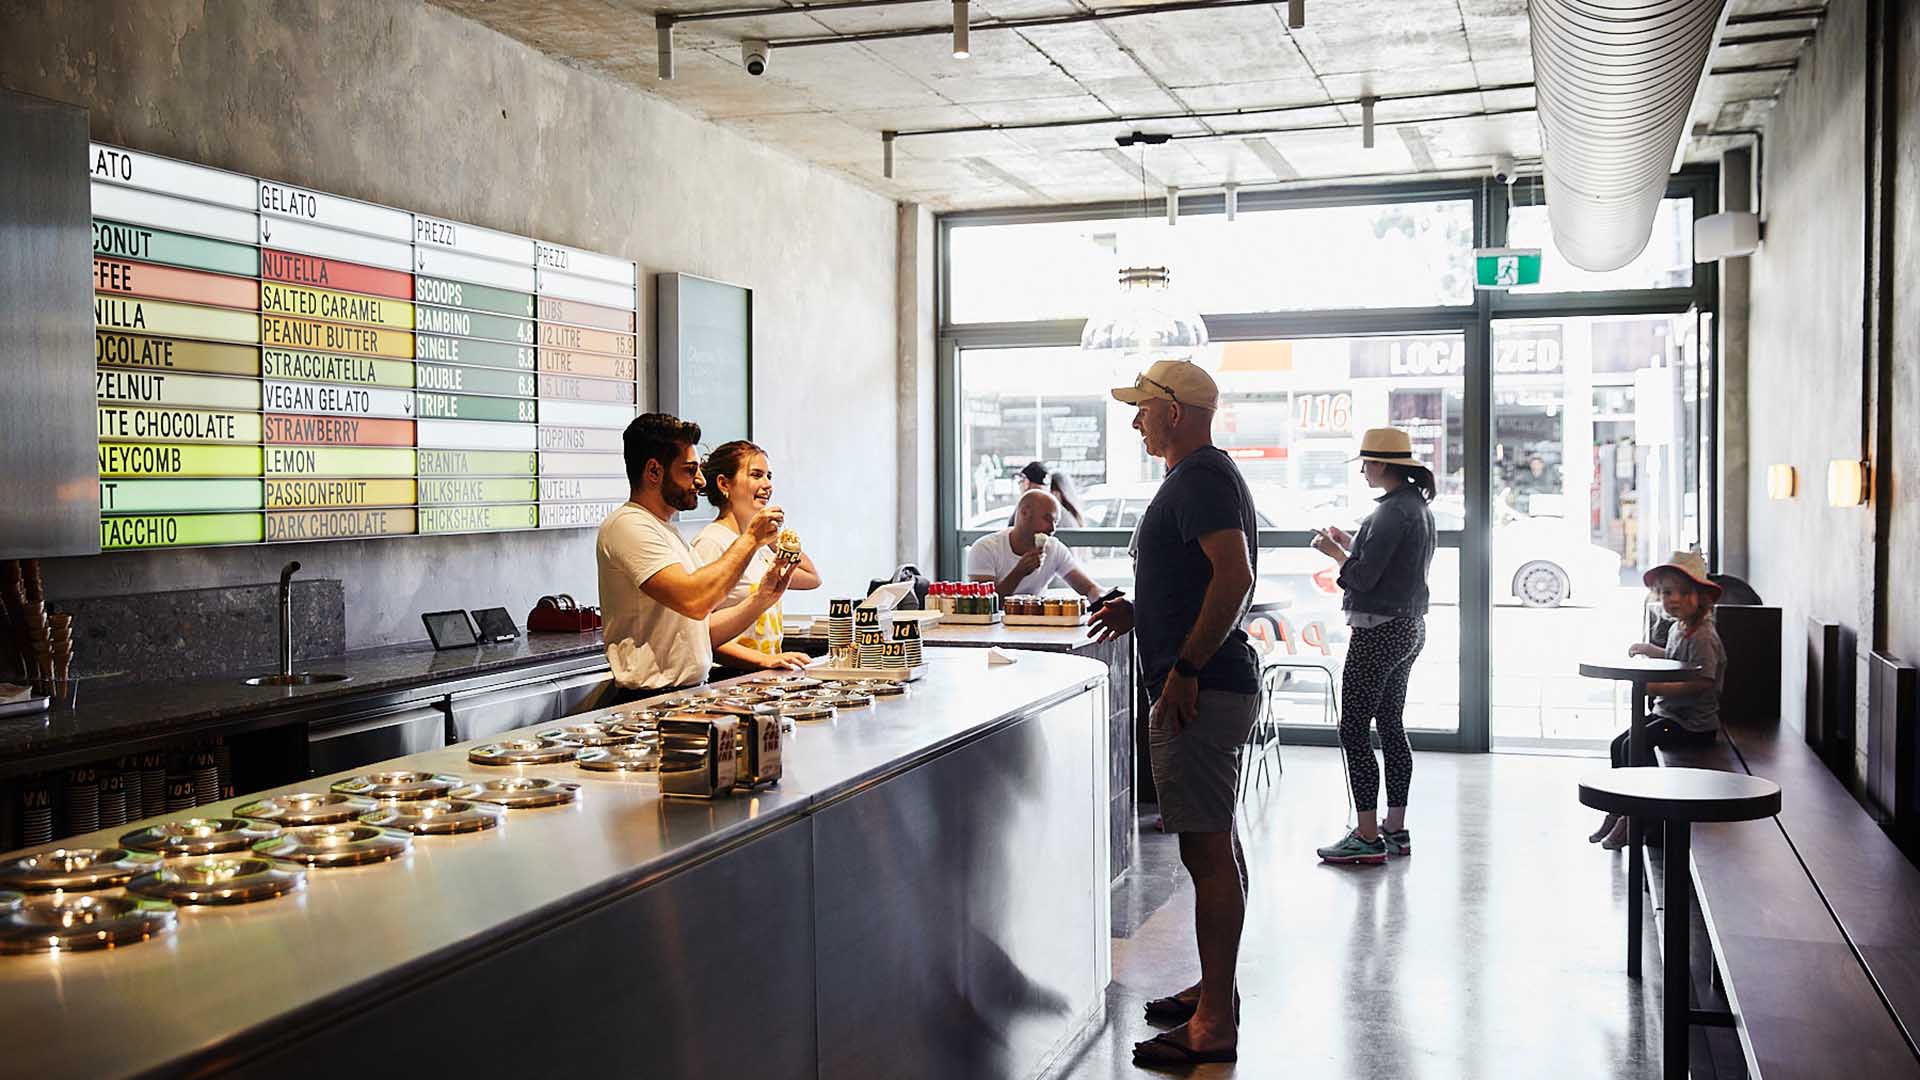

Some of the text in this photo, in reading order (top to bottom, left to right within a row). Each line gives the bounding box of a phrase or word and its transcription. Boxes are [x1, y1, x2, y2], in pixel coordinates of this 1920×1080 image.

[90, 150, 132, 181] ATO
[261, 185, 317, 219] GELATO
[417, 219, 457, 247] PREZZI
[262, 252, 329, 285] NUTELLA
[263, 286, 385, 323] SALTED CARAMEL
[417, 278, 463, 306] SCOOPS
[417, 308, 471, 335] BAMBINO
[263, 319, 378, 352] PEANUT BUTTER
[417, 336, 459, 361] SINGLE
[556, 327, 581, 348] LITRE
[264, 351, 377, 382] STRACCIATELLA
[546, 351, 572, 372] LITRE
[417, 366, 463, 390] DOUBLE
[265, 385, 370, 413] VEGAN GELATO
[417, 394, 458, 418] TRIPLE
[135, 411, 235, 438] CHOCOLATE
[1298, 393, 1351, 432] 116
[265, 417, 360, 443] STRAWBERRY
[540, 428, 585, 449] TOPPINGS
[266, 450, 316, 473] LEMON
[419, 452, 469, 473] GRANITA
[266, 482, 367, 505] PASSIONFRUIT
[420, 481, 484, 502] MILKSHAKE
[540, 480, 582, 500] NUTELLA
[267, 512, 387, 539] DARK CHOCOLATE
[420, 508, 490, 531] THICKSHAKE
